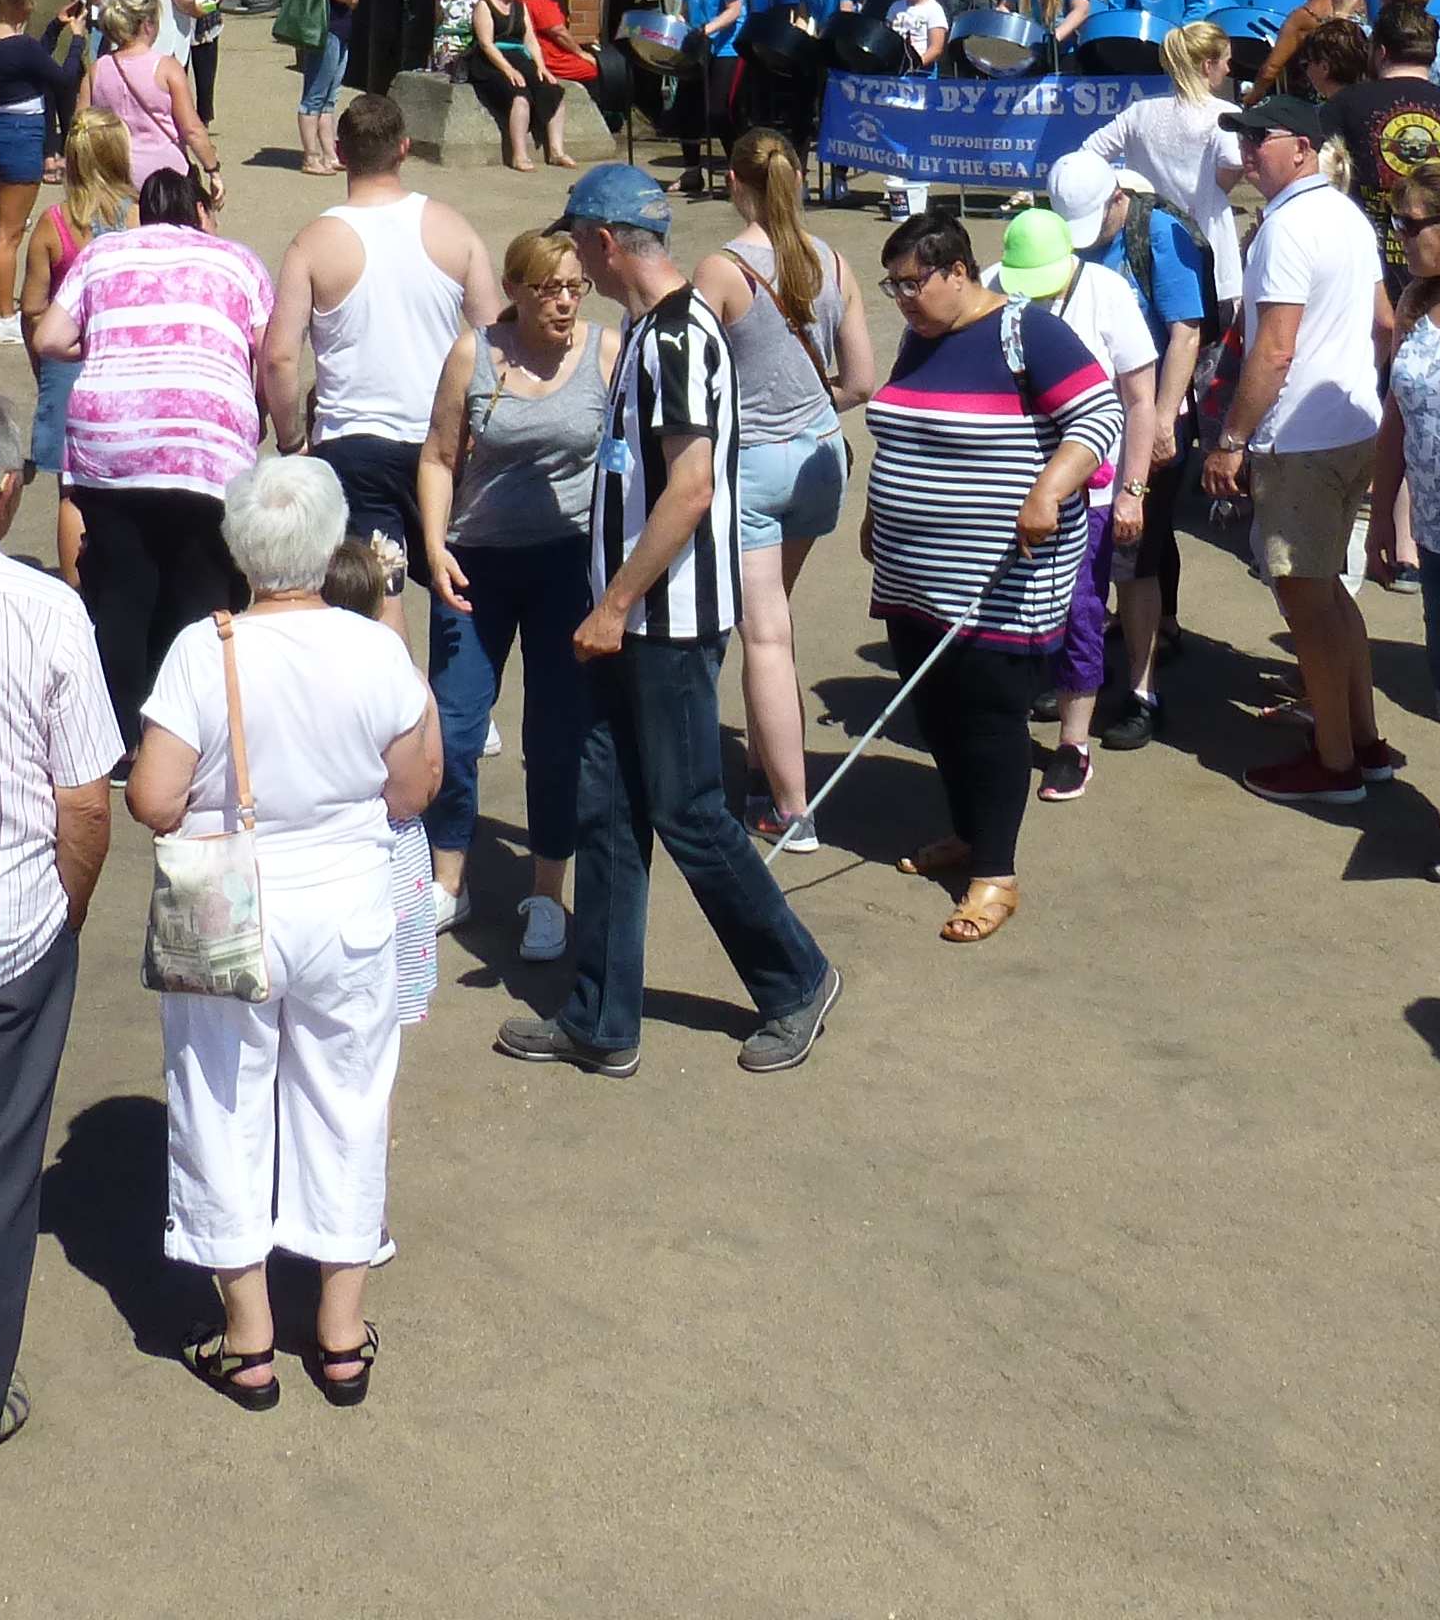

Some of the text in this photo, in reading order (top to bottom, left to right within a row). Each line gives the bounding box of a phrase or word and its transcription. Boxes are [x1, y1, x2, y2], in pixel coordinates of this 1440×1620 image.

[936, 85, 987, 114] BY
[992, 82, 1065, 116] THE
[827, 137, 915, 171] NEWBIGGIN
[918, 155, 942, 173] BY
[945, 158, 986, 176] THE
[989, 161, 1031, 179] SEA
[930, 134, 1037, 152] SUPPORTED BY
